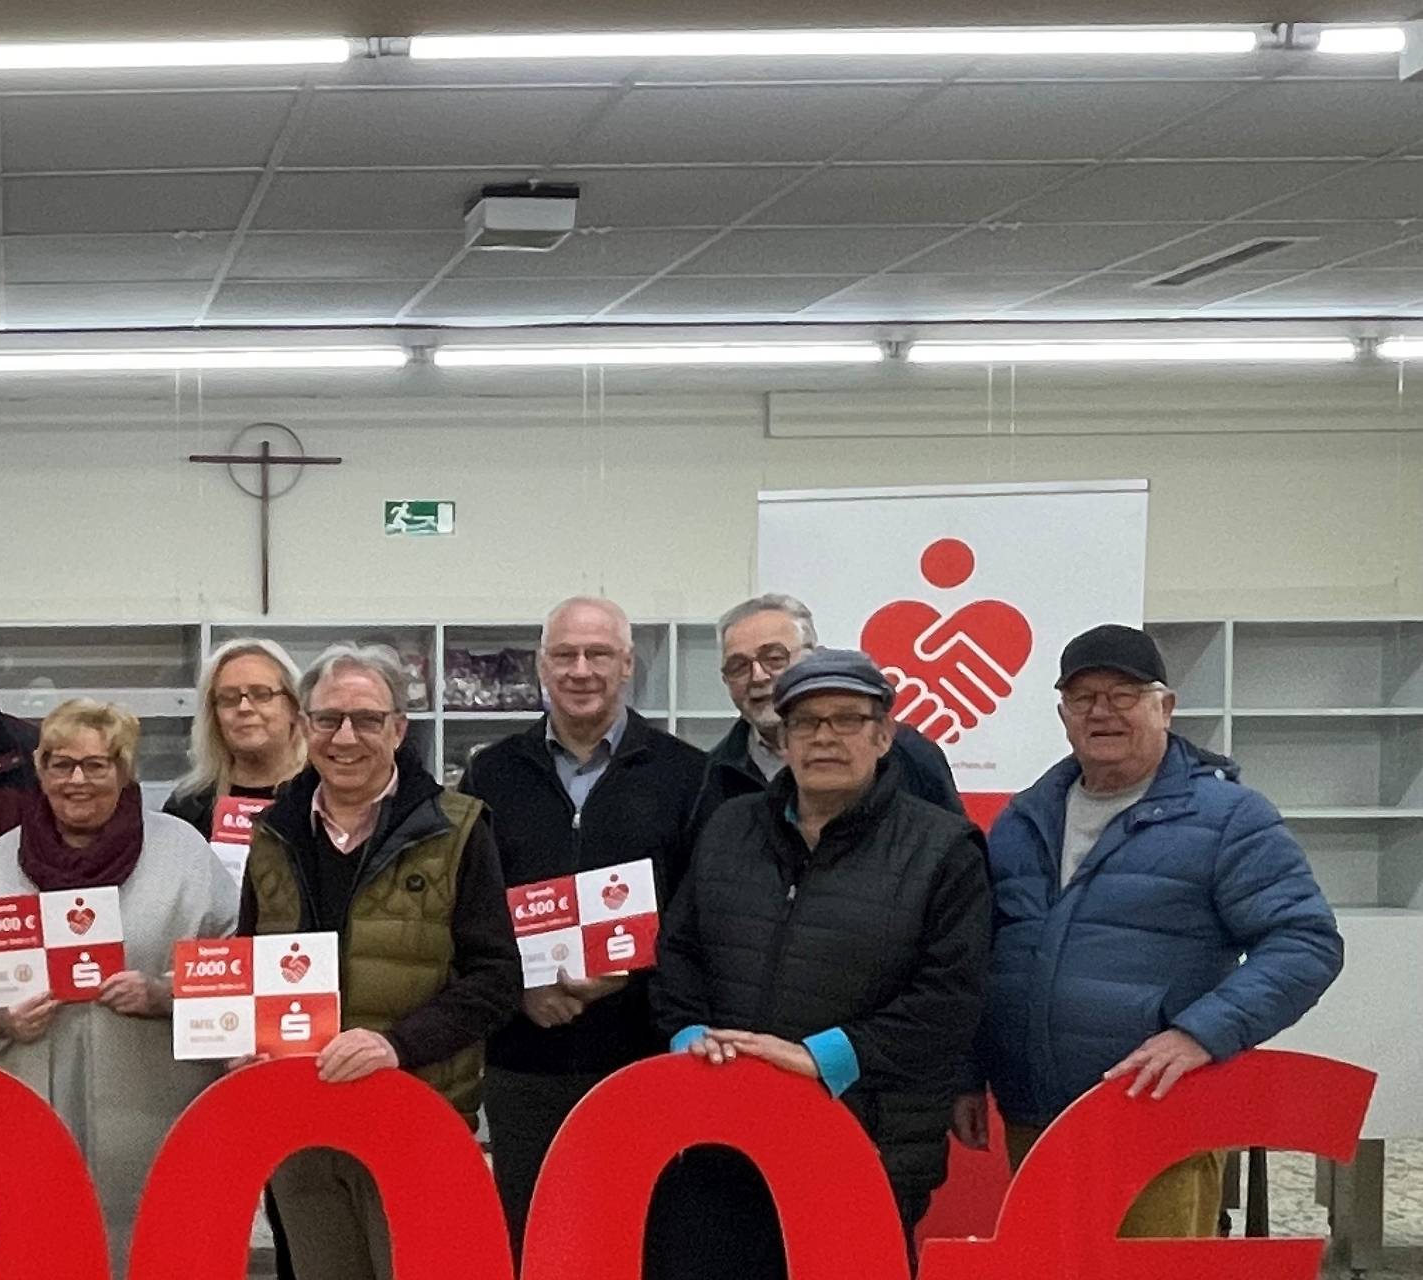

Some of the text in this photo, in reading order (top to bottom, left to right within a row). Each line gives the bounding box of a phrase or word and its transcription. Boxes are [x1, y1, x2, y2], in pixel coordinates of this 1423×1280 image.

[515, 896, 569, 919] 6.500 €
[25, 914, 36, 929] €
[185, 959, 242, 979] 7.000 €
